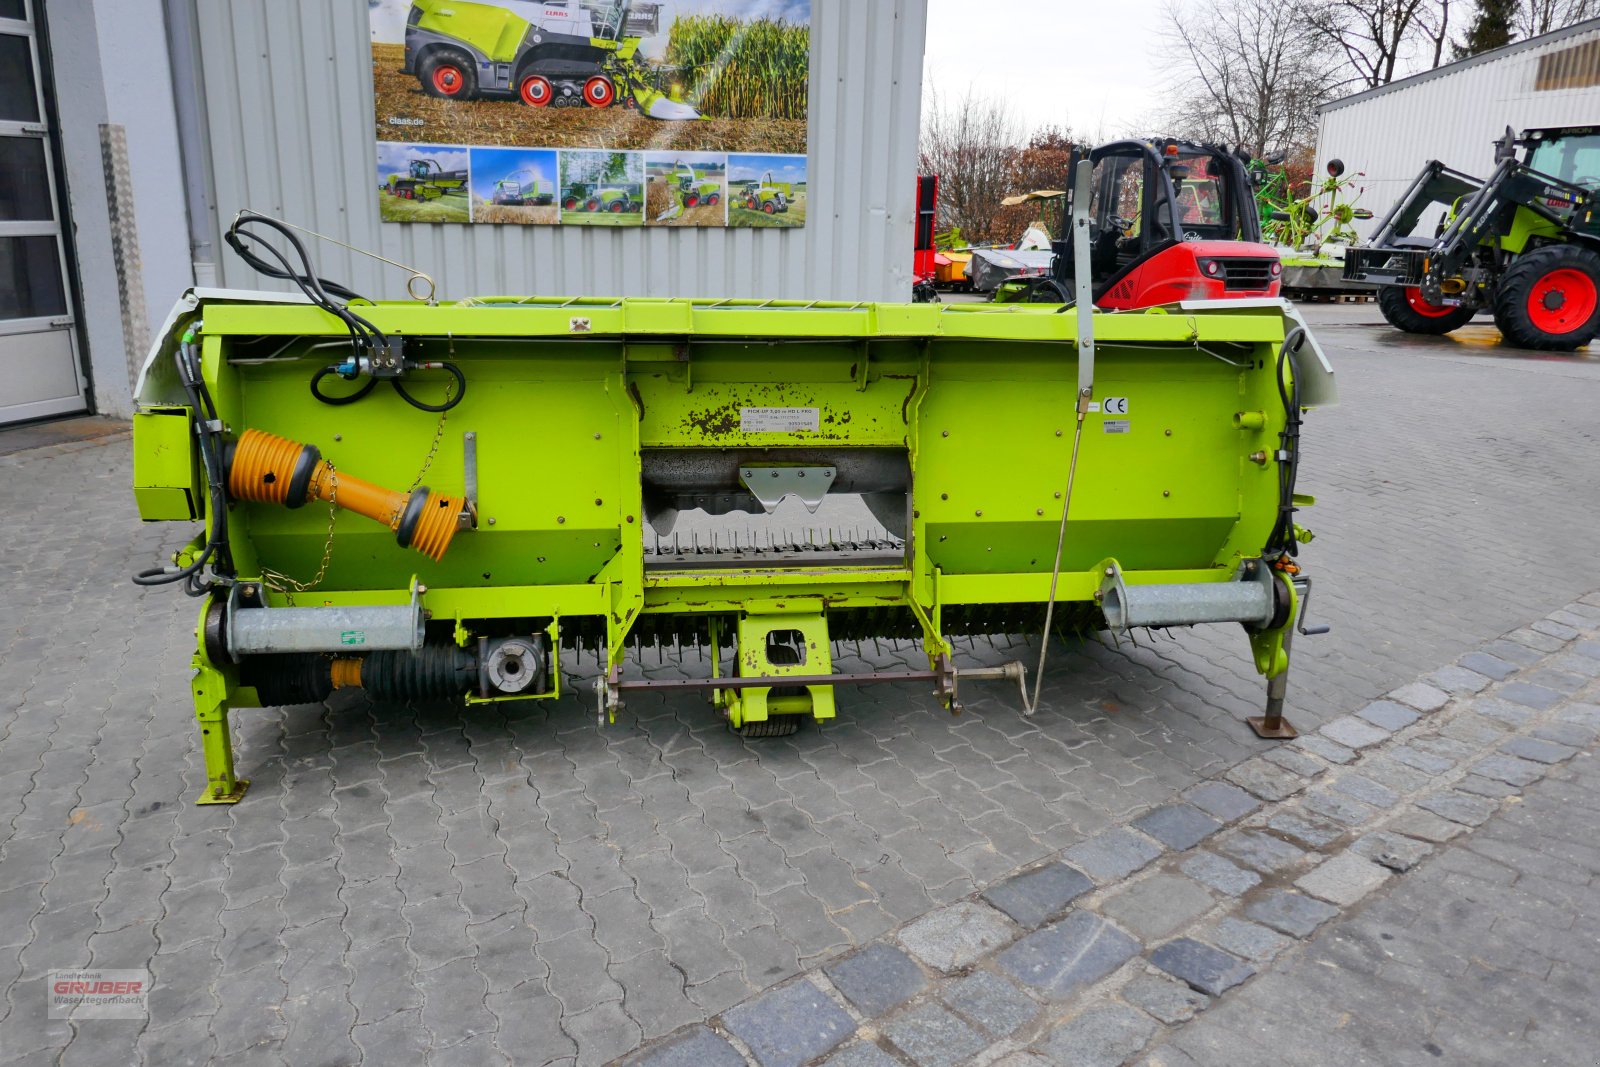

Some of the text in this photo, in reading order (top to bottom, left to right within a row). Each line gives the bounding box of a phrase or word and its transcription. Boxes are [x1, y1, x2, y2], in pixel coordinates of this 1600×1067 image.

[545, 9, 568, 18] CLAAS
[389, 116, 424, 125] claas.de
[1105, 398, 1125, 413] CE
